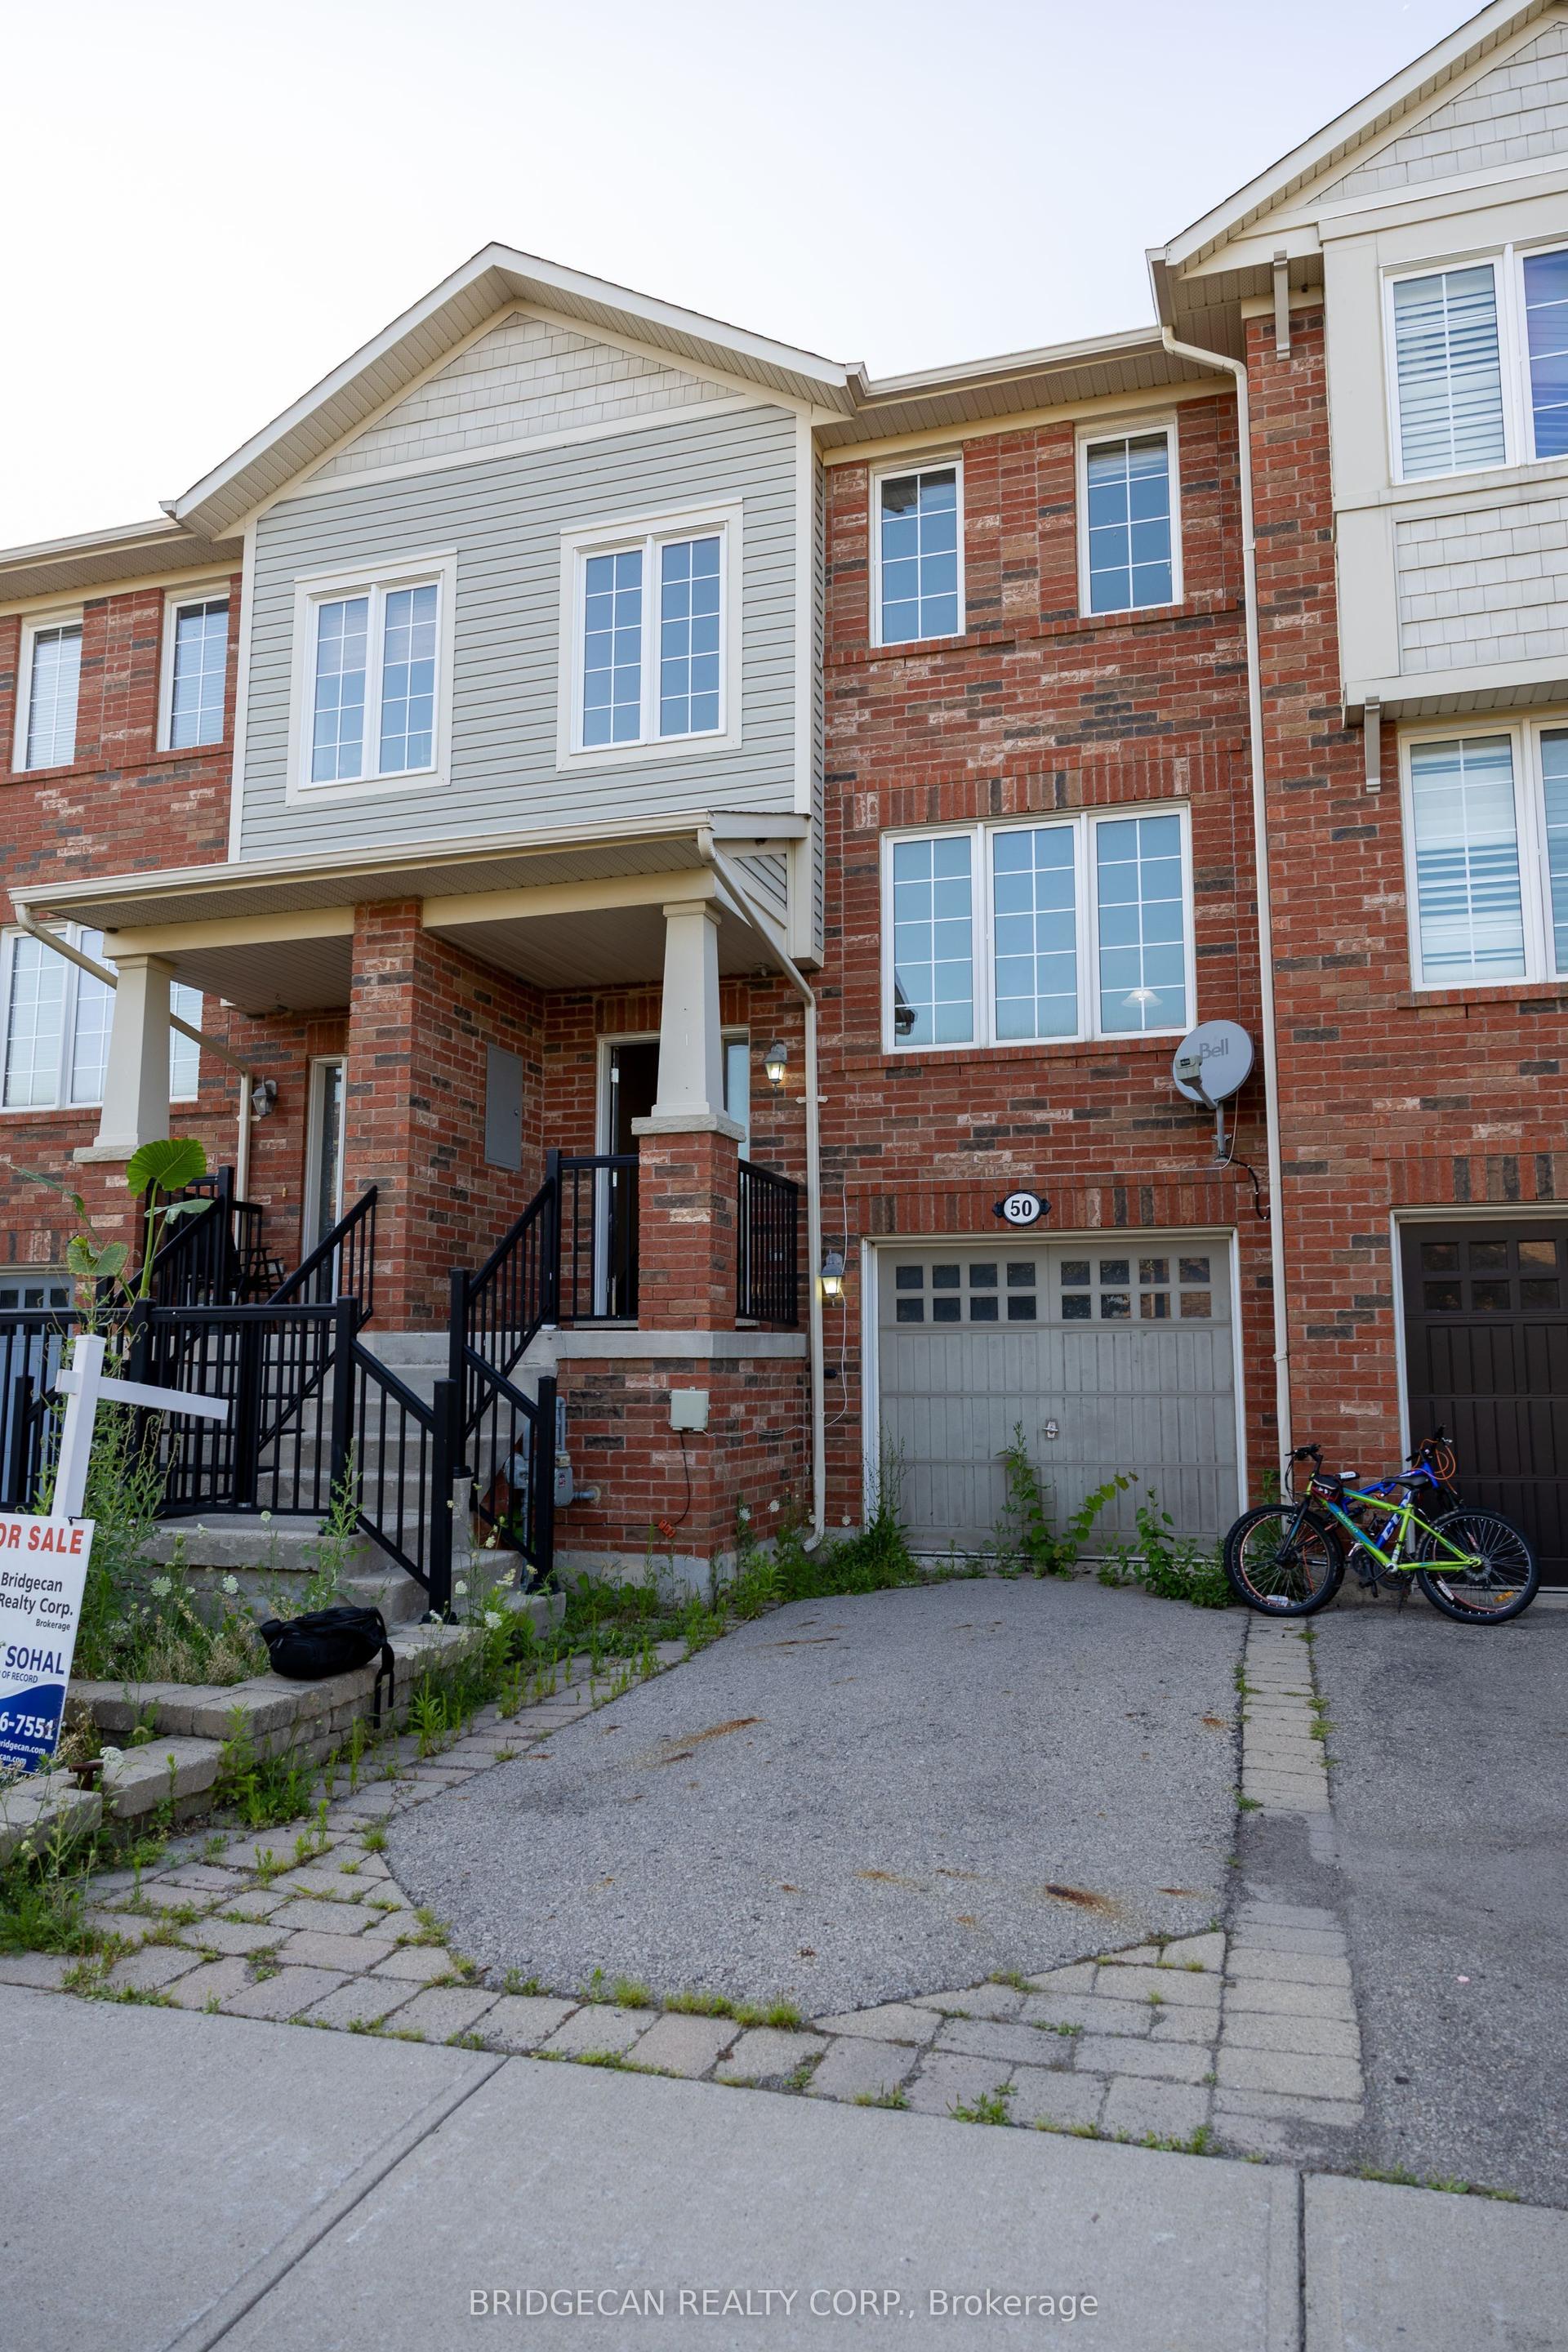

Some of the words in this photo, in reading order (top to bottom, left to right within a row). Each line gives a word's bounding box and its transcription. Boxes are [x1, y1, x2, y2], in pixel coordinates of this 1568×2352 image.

[1200, 1038, 1229, 1060] Bell
[1010, 1200, 1032, 1217] 50
[28, 1526, 84, 1555] SALE
[1, 1571, 63, 1593] Bridgecan
[0, 1592, 37, 1615] Realty
[39, 1597, 74, 1619] Corp.
[35, 1619, 71, 1632] Brokerage
[5, 1646, 65, 1675] SOHAL
[2, 1670, 11, 1679] OF
[11, 1672, 38, 1683] RECORD
